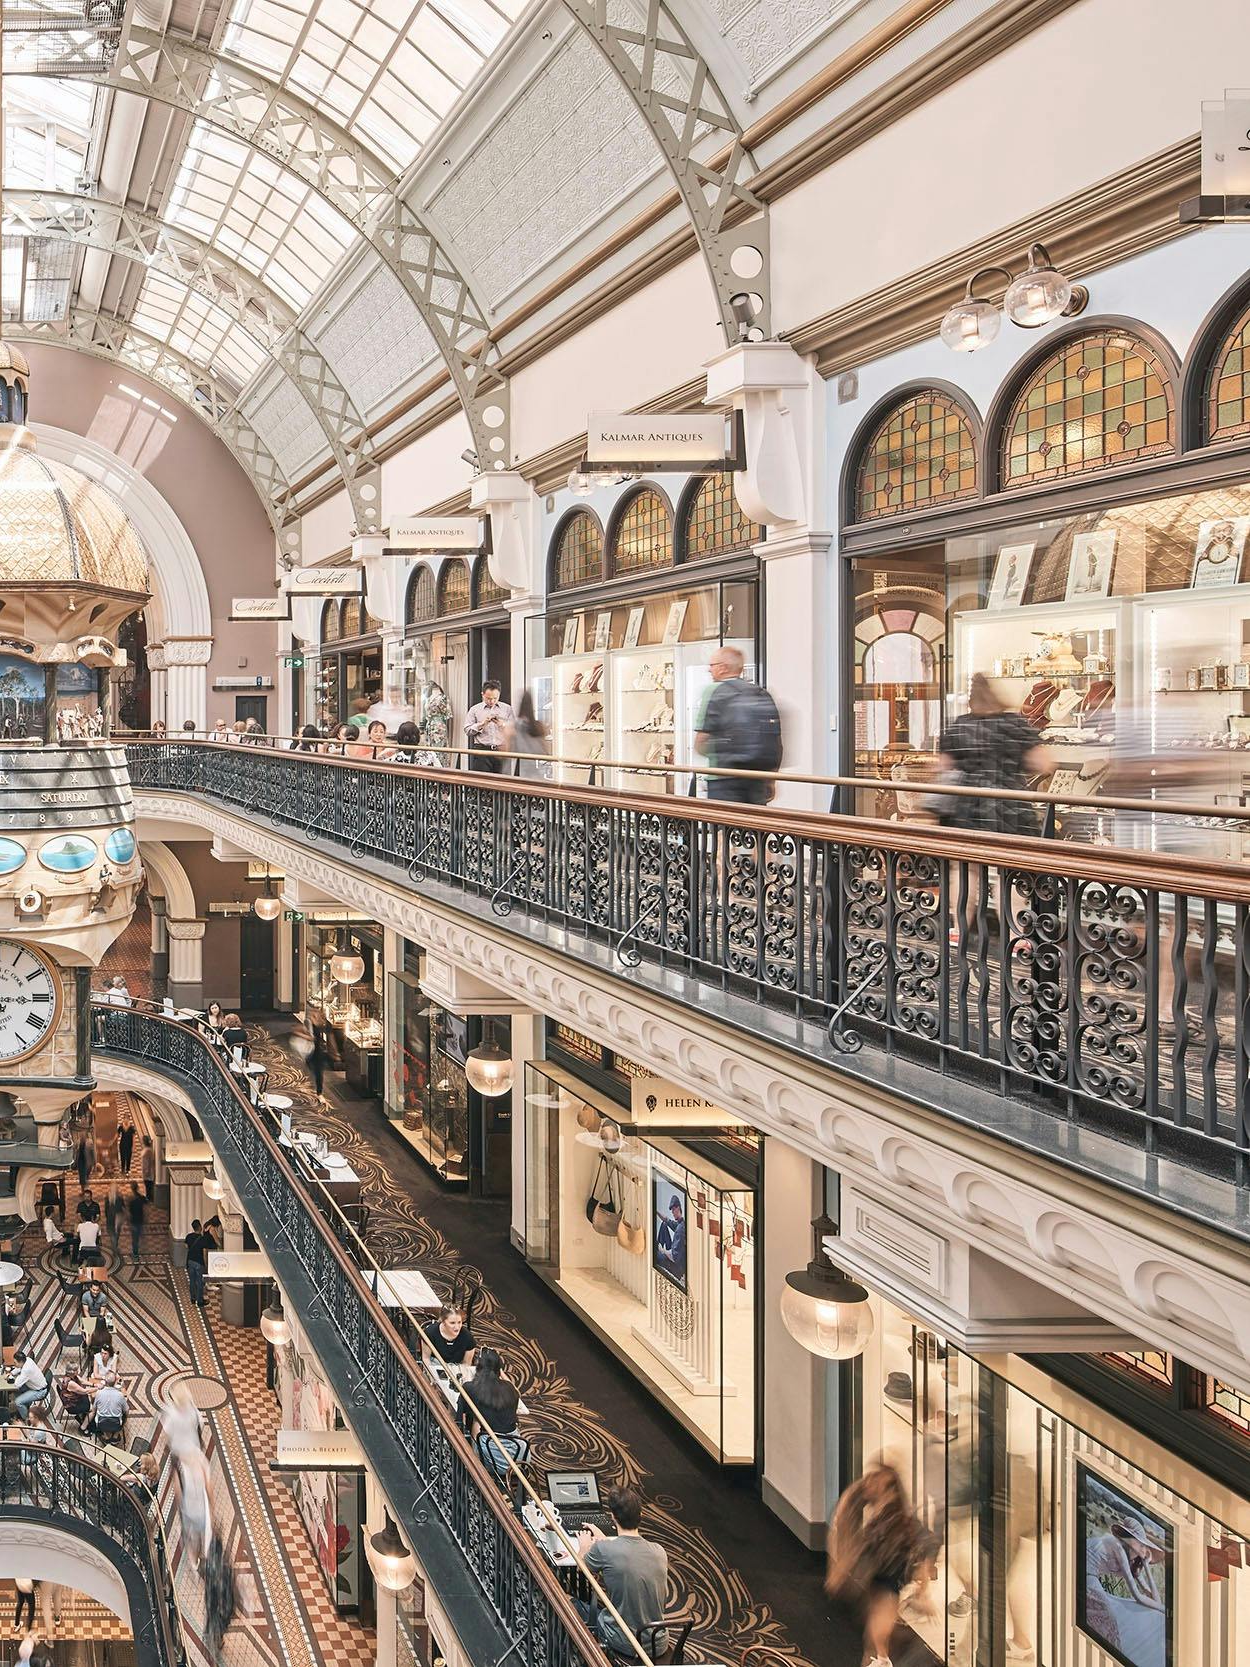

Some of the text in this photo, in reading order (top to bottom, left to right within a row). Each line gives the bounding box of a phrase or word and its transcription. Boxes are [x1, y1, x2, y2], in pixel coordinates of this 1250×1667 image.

[601, 433, 703, 443] KALMAR ANTIQUES
[428, 529, 464, 537] ANTIQUES
[40, 792, 88, 803] SATURDAY
[8, 815, 15, 824] 7
[39, 813, 46, 823] 8
[67, 813, 74, 822] 9
[665, 1099, 701, 1107] HELEN
